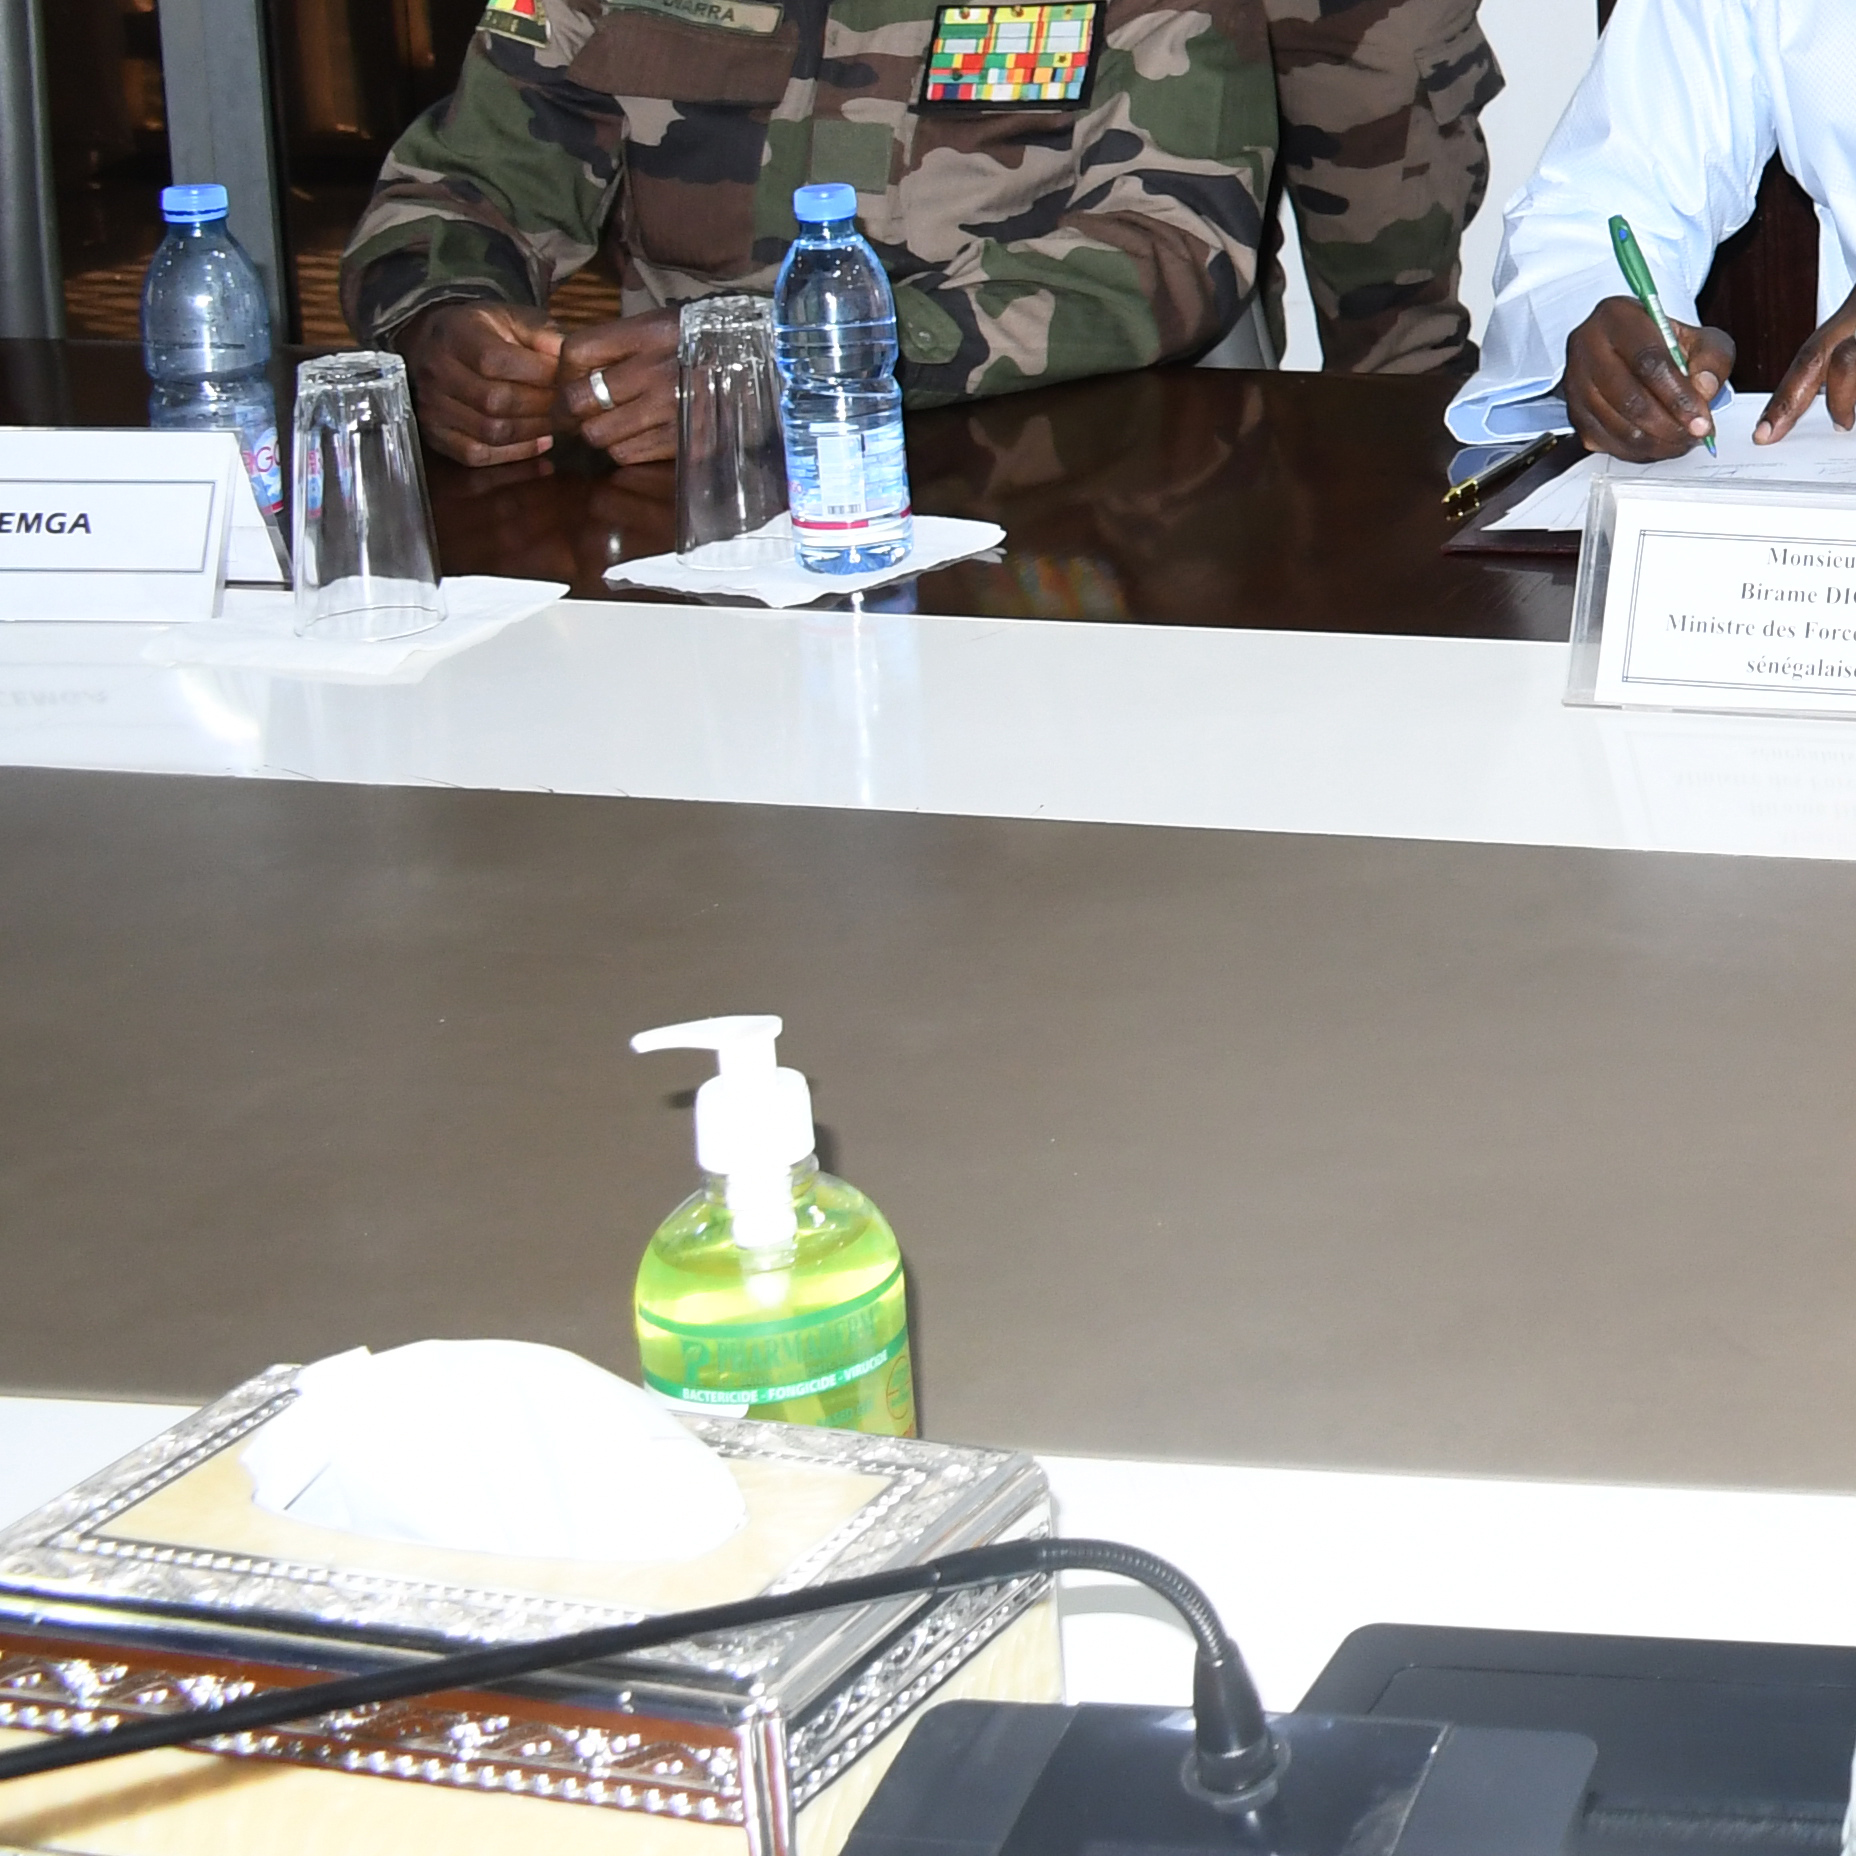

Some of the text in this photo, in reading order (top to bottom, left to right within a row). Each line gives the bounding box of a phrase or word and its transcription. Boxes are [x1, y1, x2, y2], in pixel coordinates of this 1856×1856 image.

[1740, 582, 1819, 605] Birame
[1665, 613, 1757, 638] Ministre
[1762, 619, 1797, 640] des
[682, 1387, 759, 1403] BACTERICIDE
[768, 1373, 837, 1399] FONGICIDE
